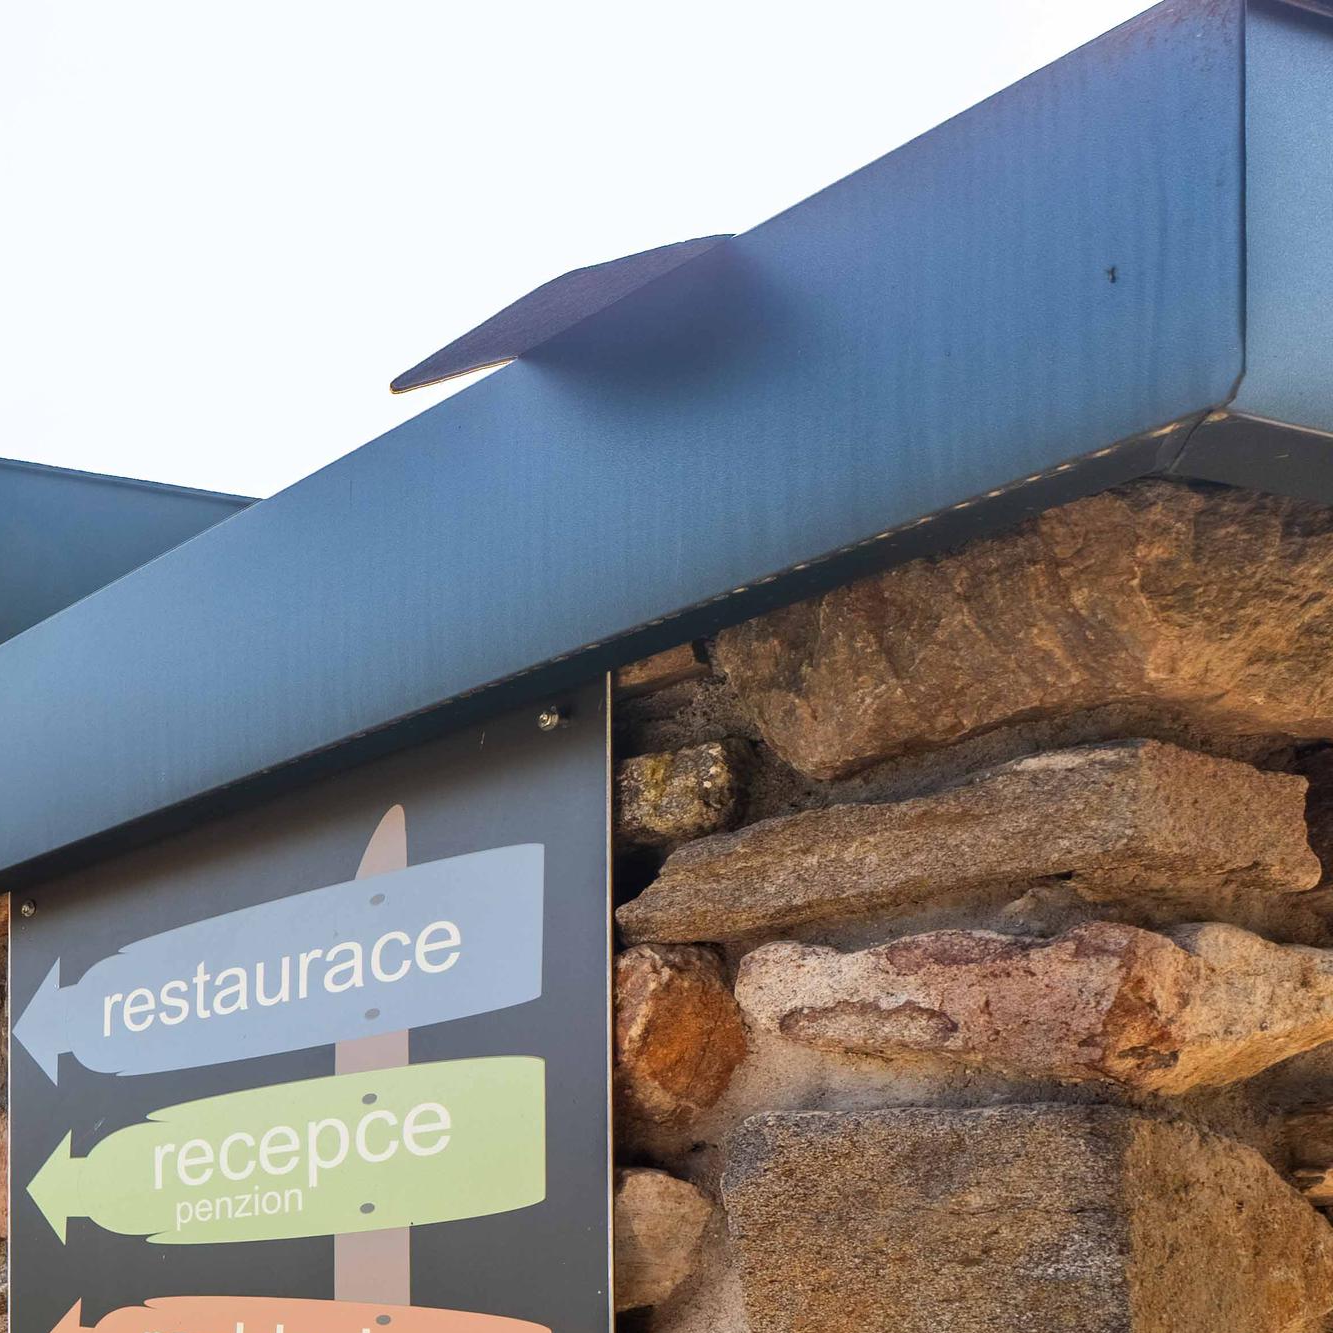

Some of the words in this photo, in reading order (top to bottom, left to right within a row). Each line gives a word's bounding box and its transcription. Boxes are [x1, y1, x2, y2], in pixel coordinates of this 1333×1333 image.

[102, 919, 463, 1037] restaurace
[153, 1102, 452, 1190] recepce
[176, 1185, 303, 1231] penzion
